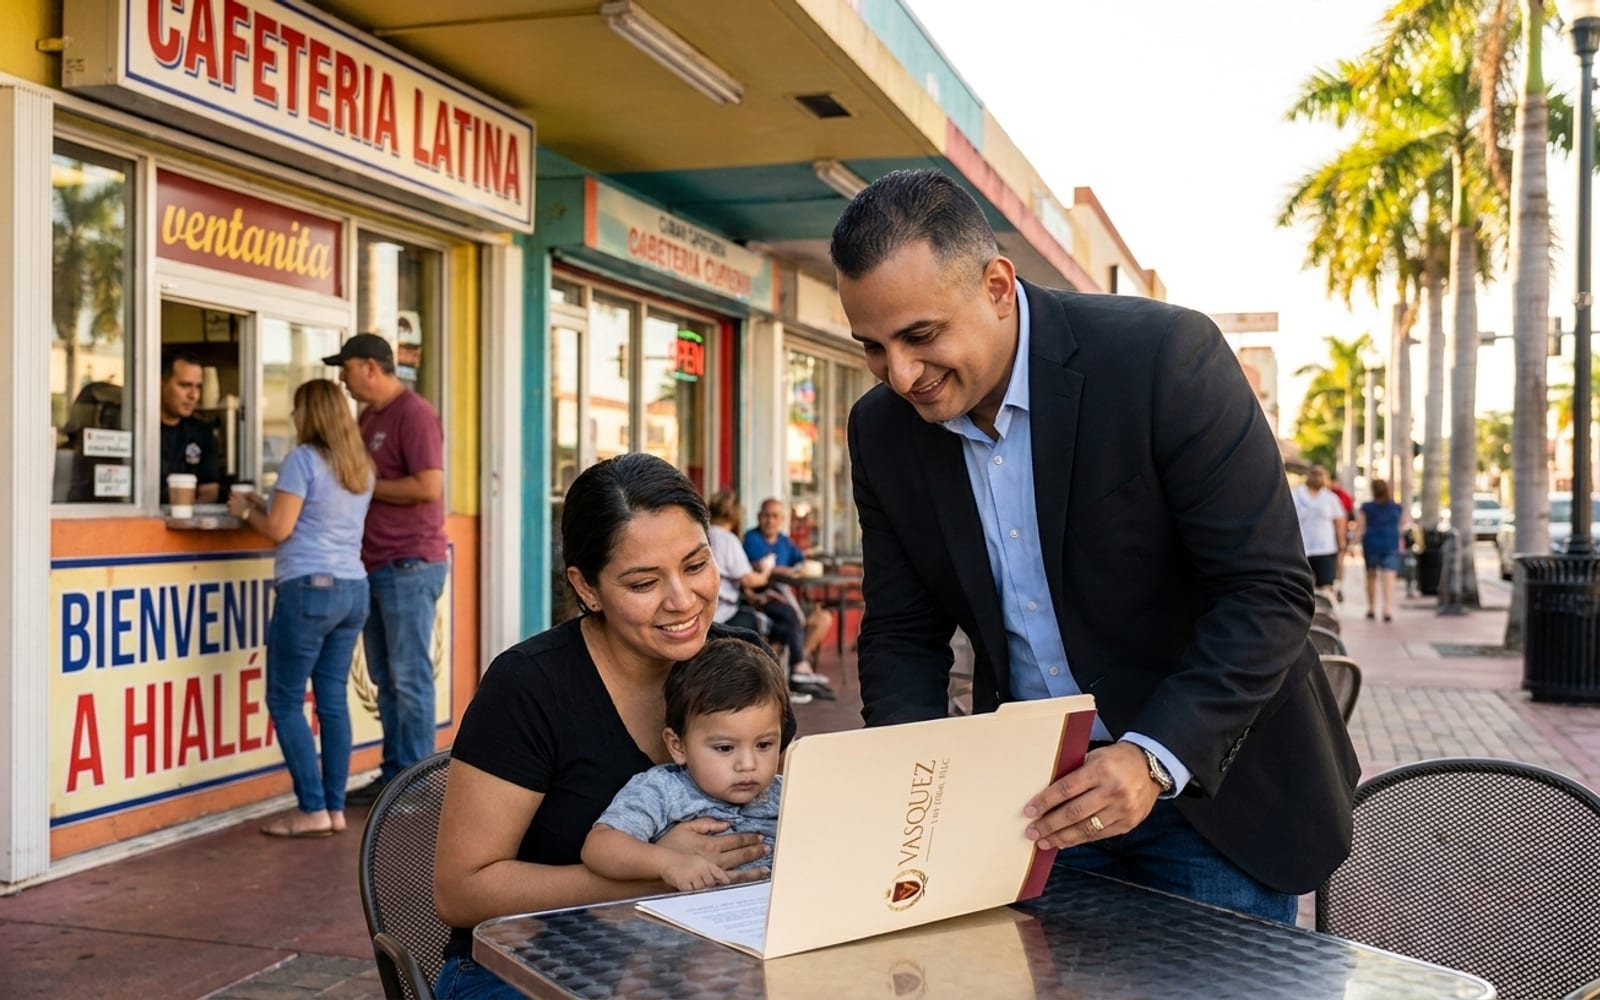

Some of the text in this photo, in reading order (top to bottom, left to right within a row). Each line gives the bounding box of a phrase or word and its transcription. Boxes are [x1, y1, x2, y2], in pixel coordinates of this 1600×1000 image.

[148, 0, 521, 206] CAFETERIA LATINA
[162, 204, 332, 280] ventanita
[66, 652, 320, 793] A HIALÉ
[898, 760, 936, 867] VASQUEZ
